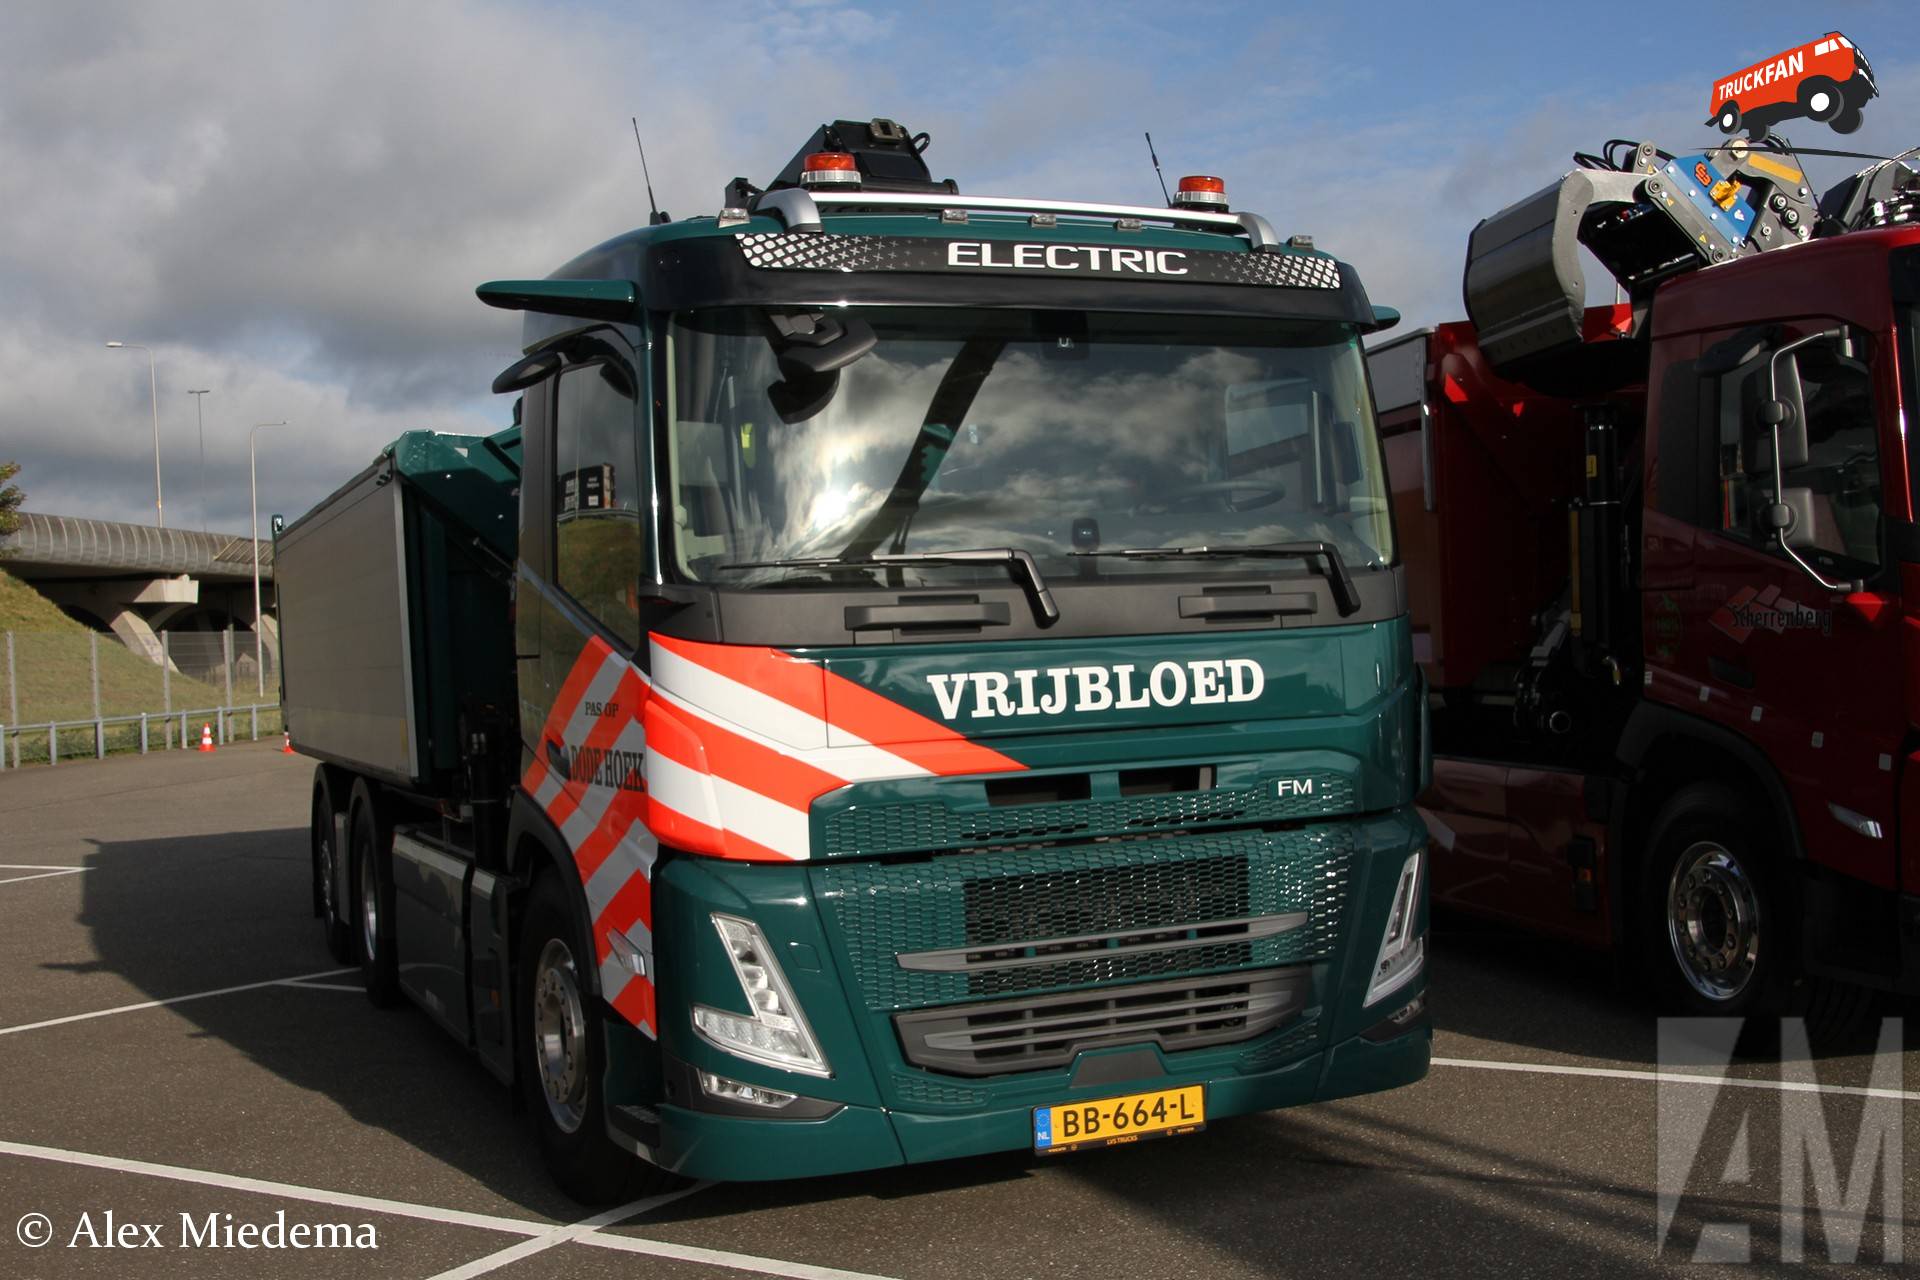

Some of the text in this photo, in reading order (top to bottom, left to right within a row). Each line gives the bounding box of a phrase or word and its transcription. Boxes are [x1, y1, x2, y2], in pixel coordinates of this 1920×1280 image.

[947, 242, 1189, 275] ELECTRIC
[1733, 601, 1832, 638] Scherrenberg
[926, 658, 1266, 721] VRIJBLOED
[584, 701, 619, 718] PAS OP
[570, 744, 645, 793] DODE HOEK
[1277, 778, 1314, 797] FM
[1037, 1093, 1195, 1141] NL BB-664-L
